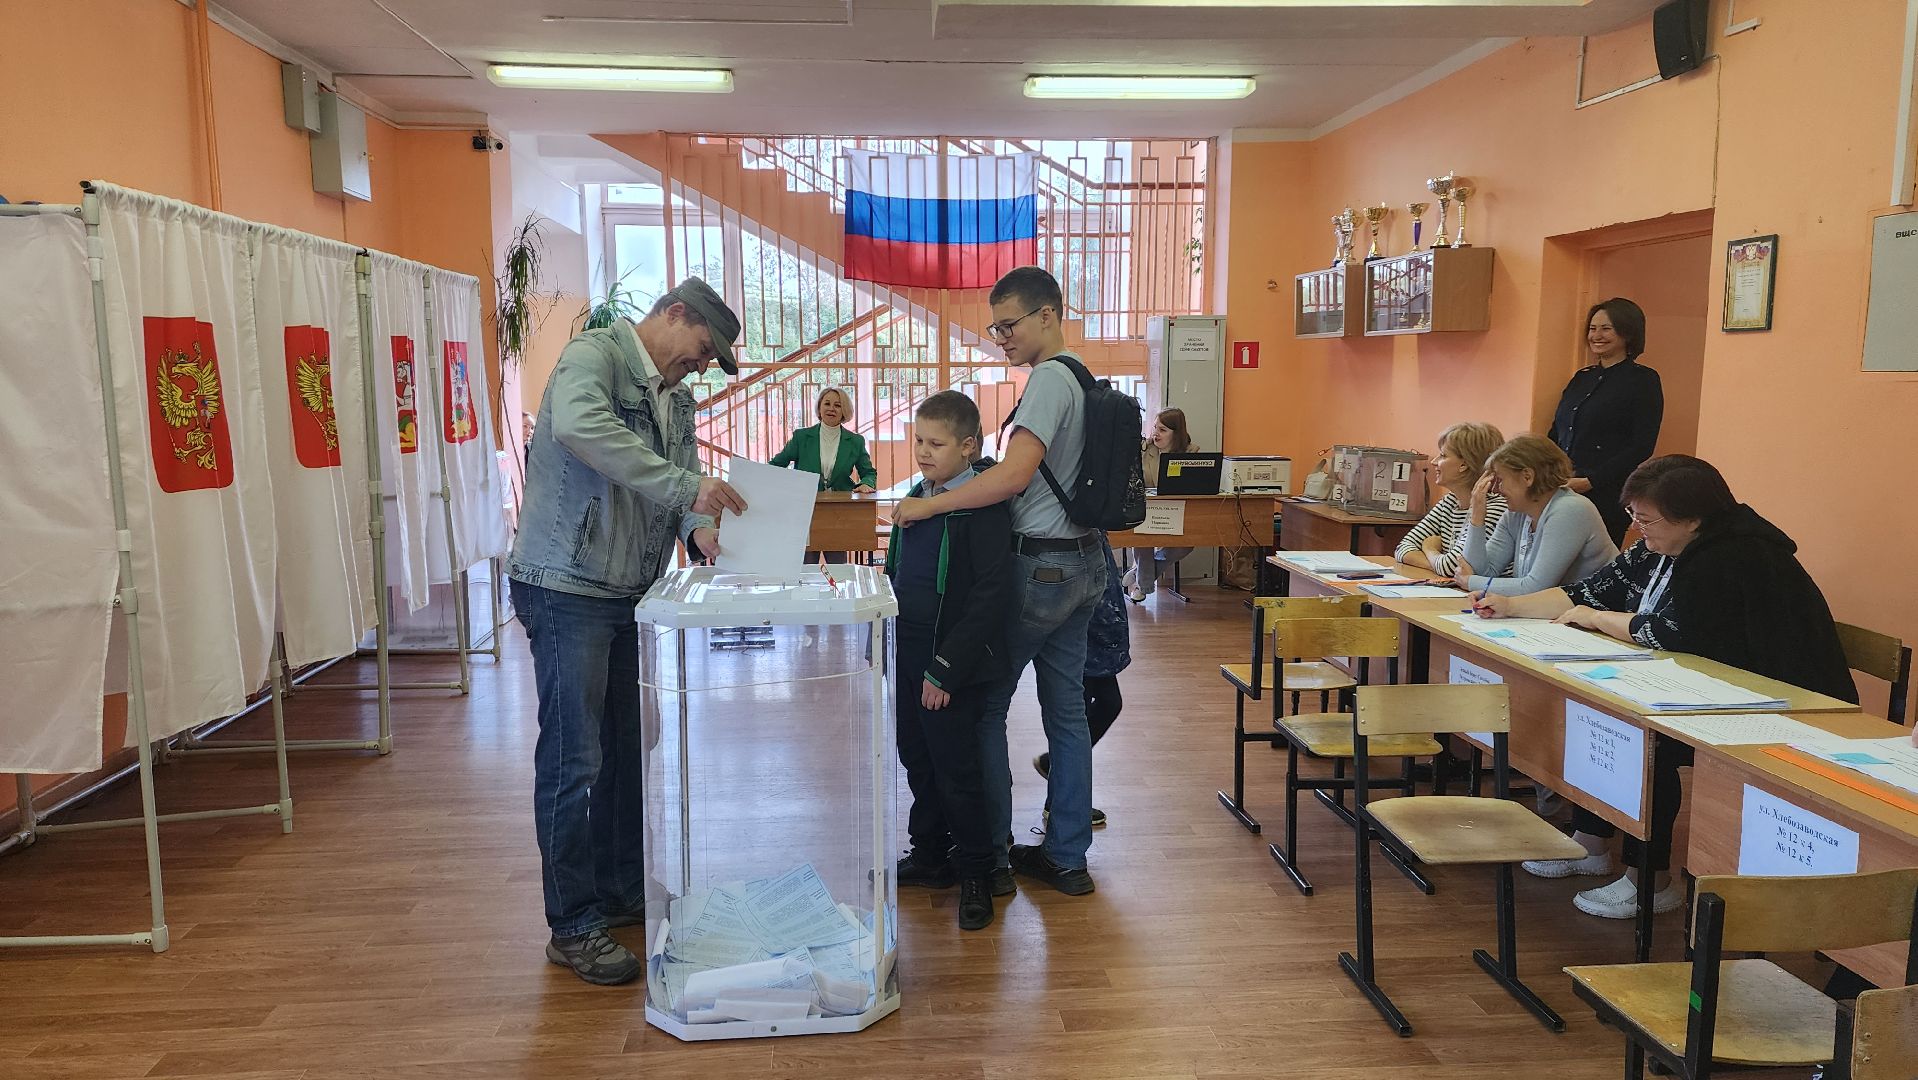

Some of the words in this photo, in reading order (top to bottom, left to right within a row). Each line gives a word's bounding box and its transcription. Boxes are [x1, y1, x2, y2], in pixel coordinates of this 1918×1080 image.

[1375, 461, 1387, 479] 2
[1396, 463, 1404, 480] 1
[1335, 488, 1343, 500] 3
[1374, 488, 1389, 497] 725
[1391, 498, 1406, 507] 725
[1586, 715, 1631, 743] Хлебозаводская
[1590, 730, 1597, 739] №
[1598, 733, 1604, 743] 12
[1605, 738, 1610, 746] к
[1590, 741, 1597, 751] №
[1598, 745, 1604, 755] 12
[1589, 753, 1596, 763] №
[1597, 757, 1603, 767] 12
[1758, 804, 1770, 816] ул.
[1772, 808, 1839, 848] Хлебозаводская
[1776, 825, 1787, 839] №
[1789, 832, 1798, 844] 12
[1799, 838, 1806, 848] к
[1807, 841, 1815, 854] 4,
[1775, 841, 1786, 853] №
[1787, 846, 1797, 859] 12
[1798, 854, 1805, 863] к
